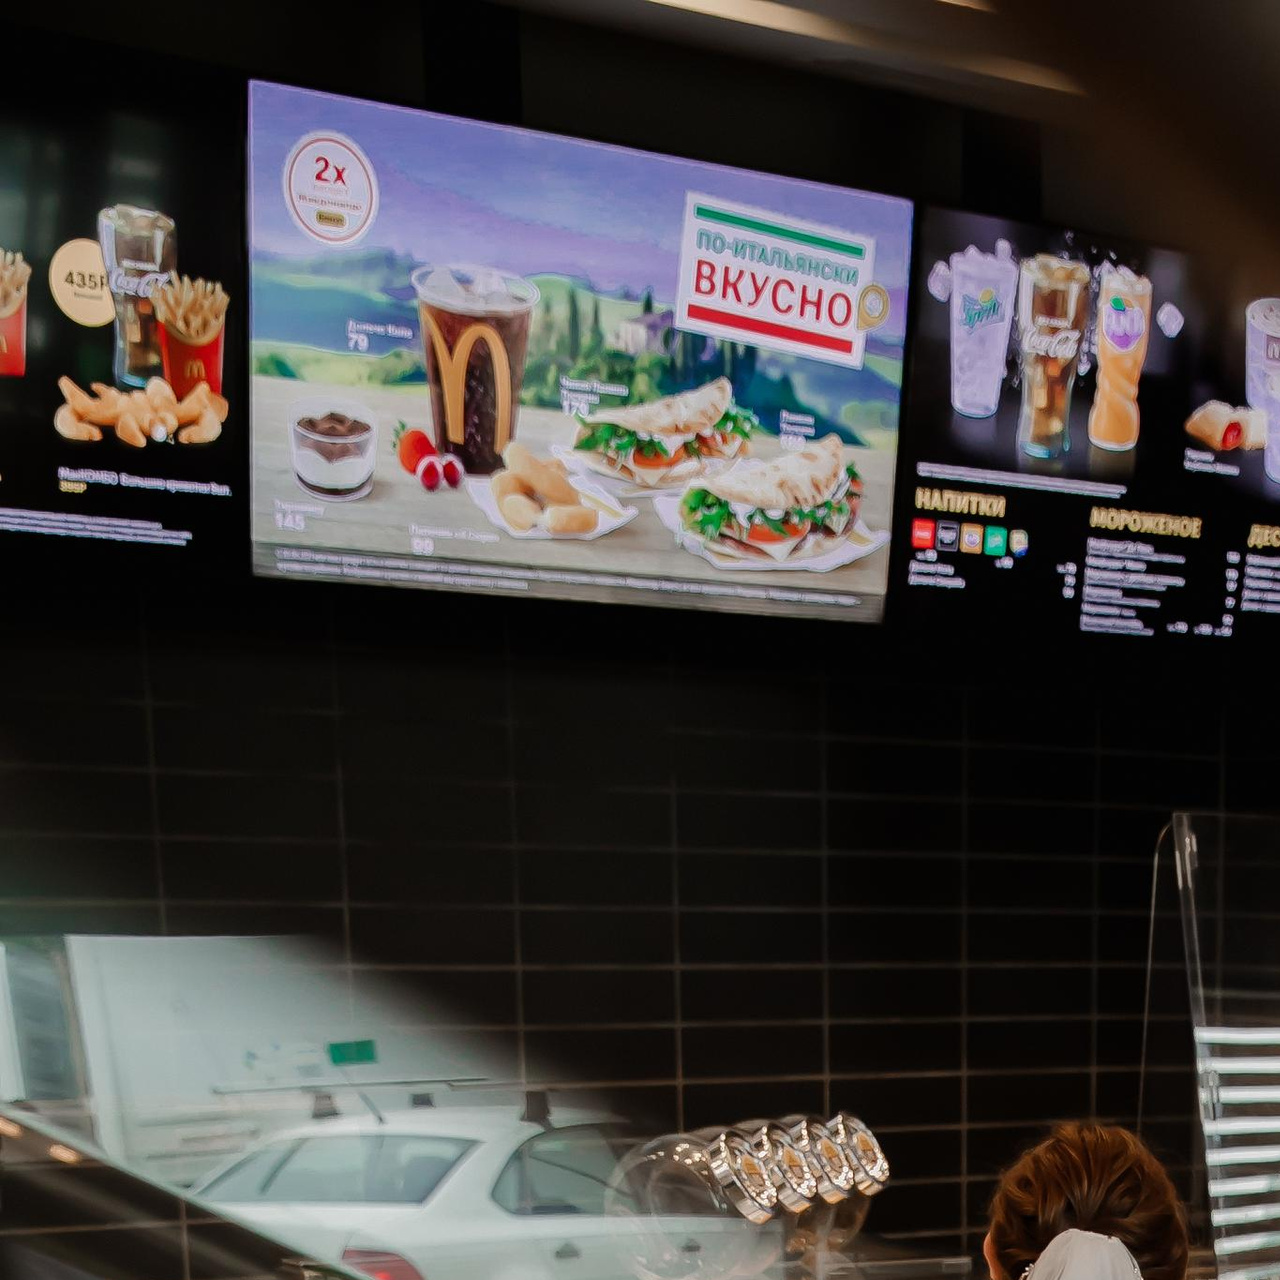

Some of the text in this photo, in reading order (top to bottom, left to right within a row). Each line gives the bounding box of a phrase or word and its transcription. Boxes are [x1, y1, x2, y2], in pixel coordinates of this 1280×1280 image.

[696, 228, 860, 287] ПО-ИТАЛЬЯНСКИ
[694, 258, 852, 328] ВКУСНО
[915, 486, 1006, 518] НАПИТКИ
[1090, 506, 1202, 539] МОРОЖЕНОЕ
